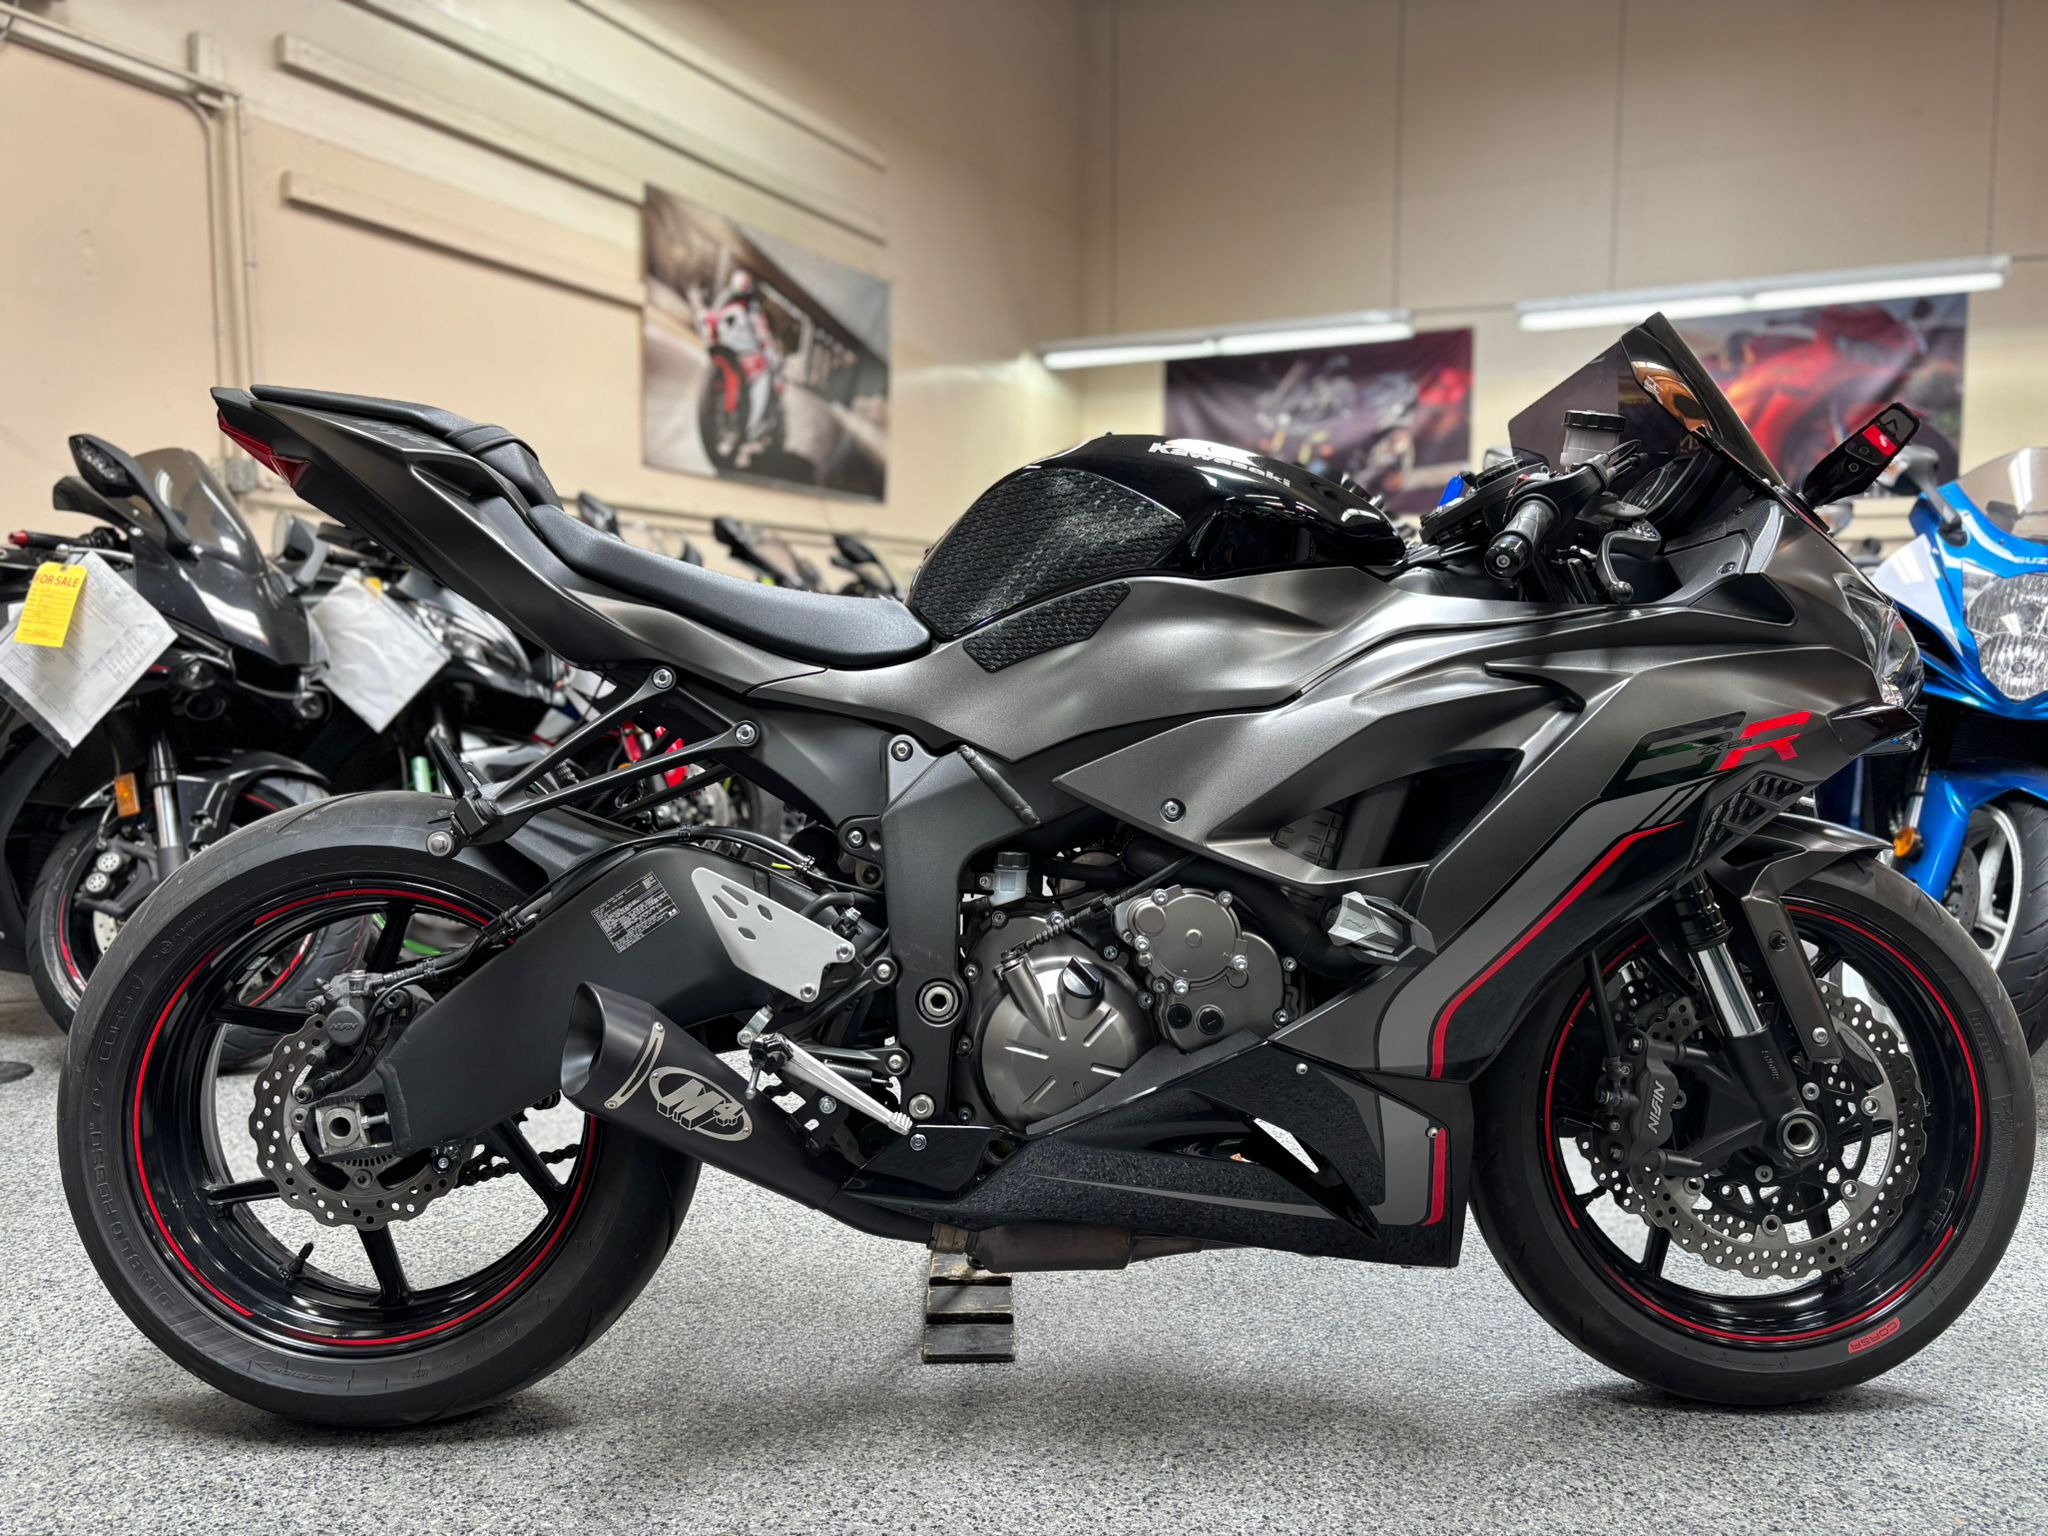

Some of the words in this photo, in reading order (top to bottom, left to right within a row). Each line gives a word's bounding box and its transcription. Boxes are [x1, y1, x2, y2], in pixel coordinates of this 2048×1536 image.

[34, 573, 54, 586] FOR
[55, 575, 80, 588] SALE
[1850, 1322, 1898, 1350] CORSA
